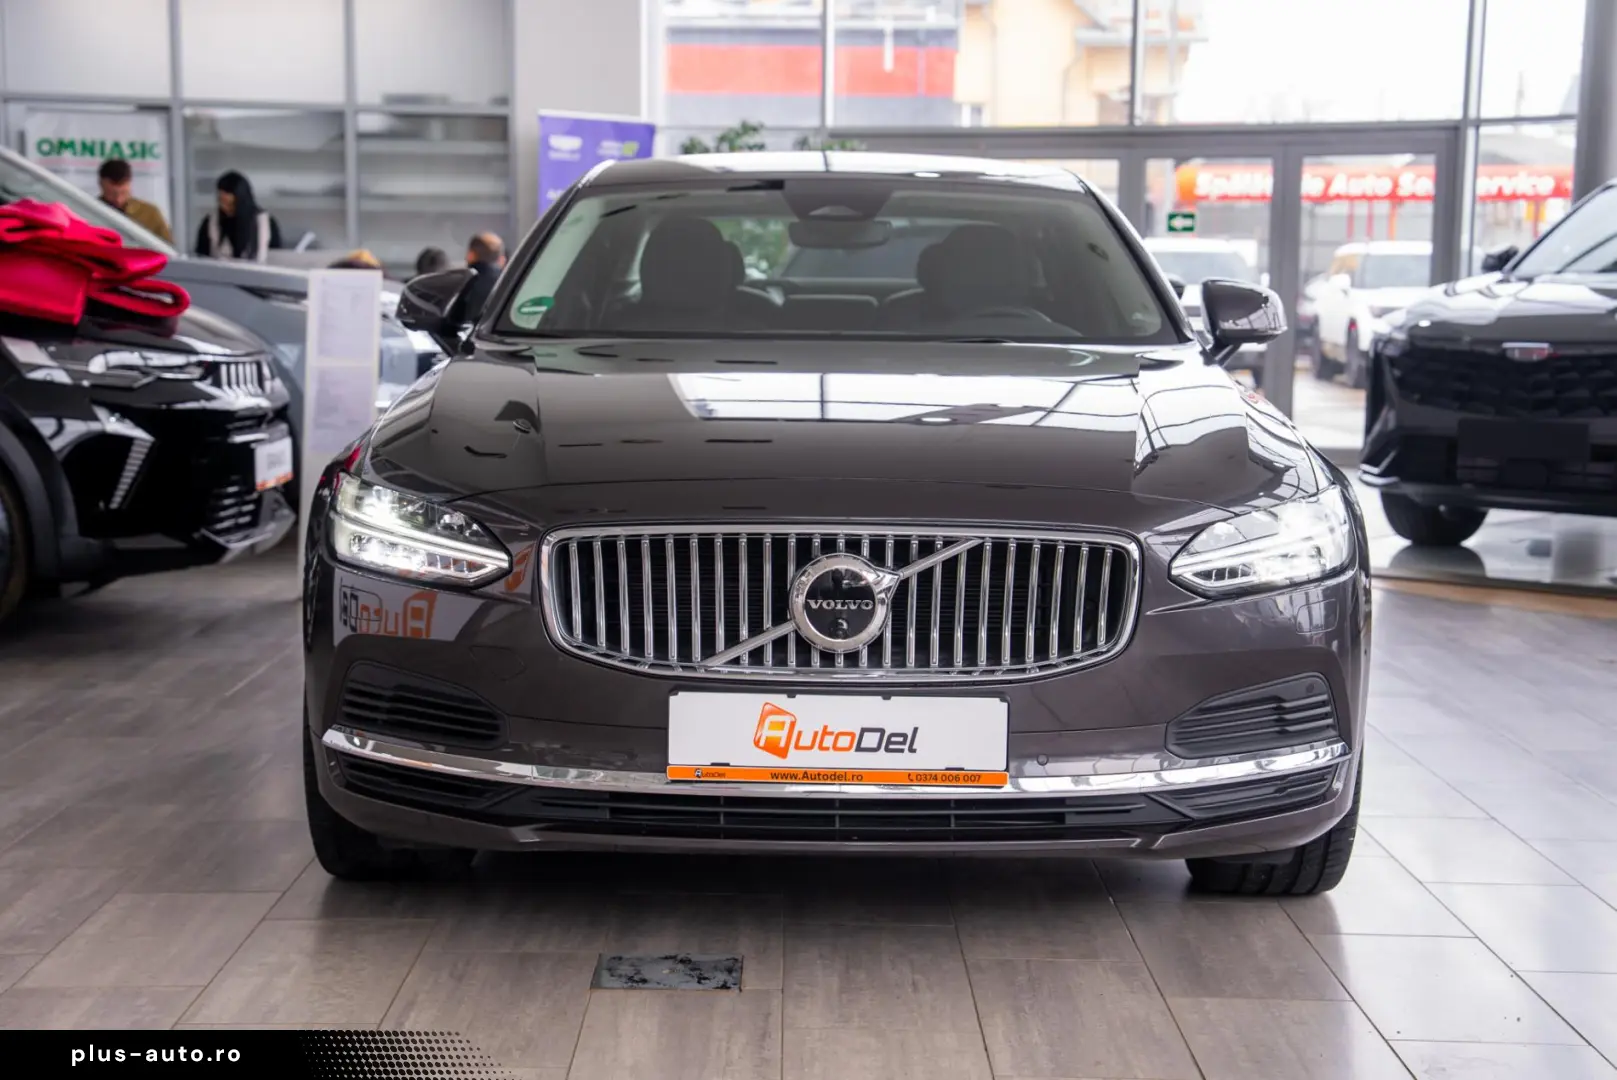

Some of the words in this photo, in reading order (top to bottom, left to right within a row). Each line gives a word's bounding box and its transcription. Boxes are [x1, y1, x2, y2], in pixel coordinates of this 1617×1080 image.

[806, 599, 874, 610] VOLVO
[755, 706, 919, 757] AutoDel
[770, 771, 864, 782] www.Autodel.ro
[915, 773, 938, 782] 0374
[940, 773, 960, 783] 006
[962, 774, 981, 783] 007
